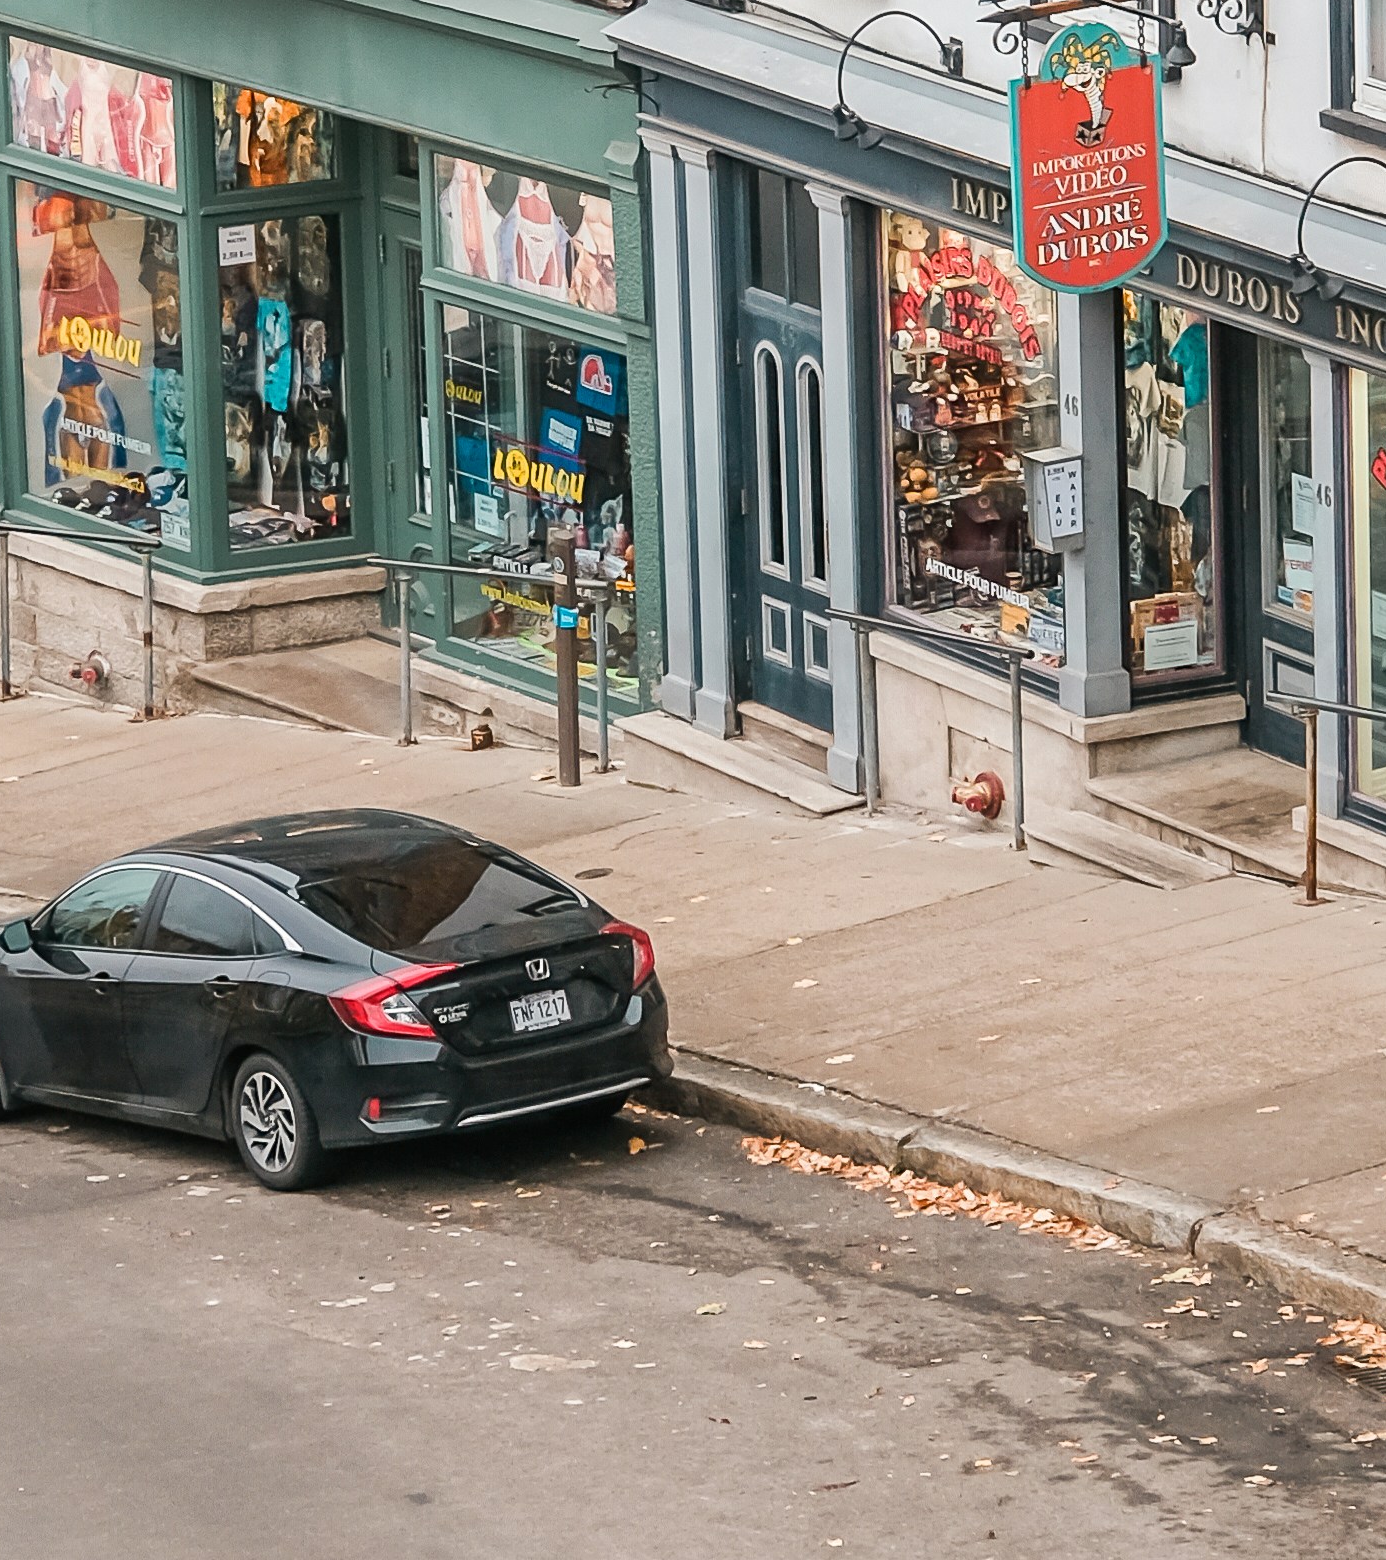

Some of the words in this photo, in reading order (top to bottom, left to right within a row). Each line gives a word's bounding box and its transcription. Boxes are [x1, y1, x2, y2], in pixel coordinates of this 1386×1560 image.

[1032, 142, 1147, 177] IMPORTATIONS
[1054, 163, 1128, 196] VIDÉO
[1041, 193, 1144, 238] ANDRÉ
[1037, 224, 1150, 266] DUBOIS
[1176, 252, 1304, 325] DUBOIS
[59, 315, 142, 368] LOULOU
[1063, 393, 1079, 417] 46
[493, 448, 586, 505] LOULOU
[1316, 483, 1332, 508] 46
[1055, 493, 1063, 527] EAU
[1067, 470, 1078, 528] WATER
[924, 556, 964, 586] ARTICLE
